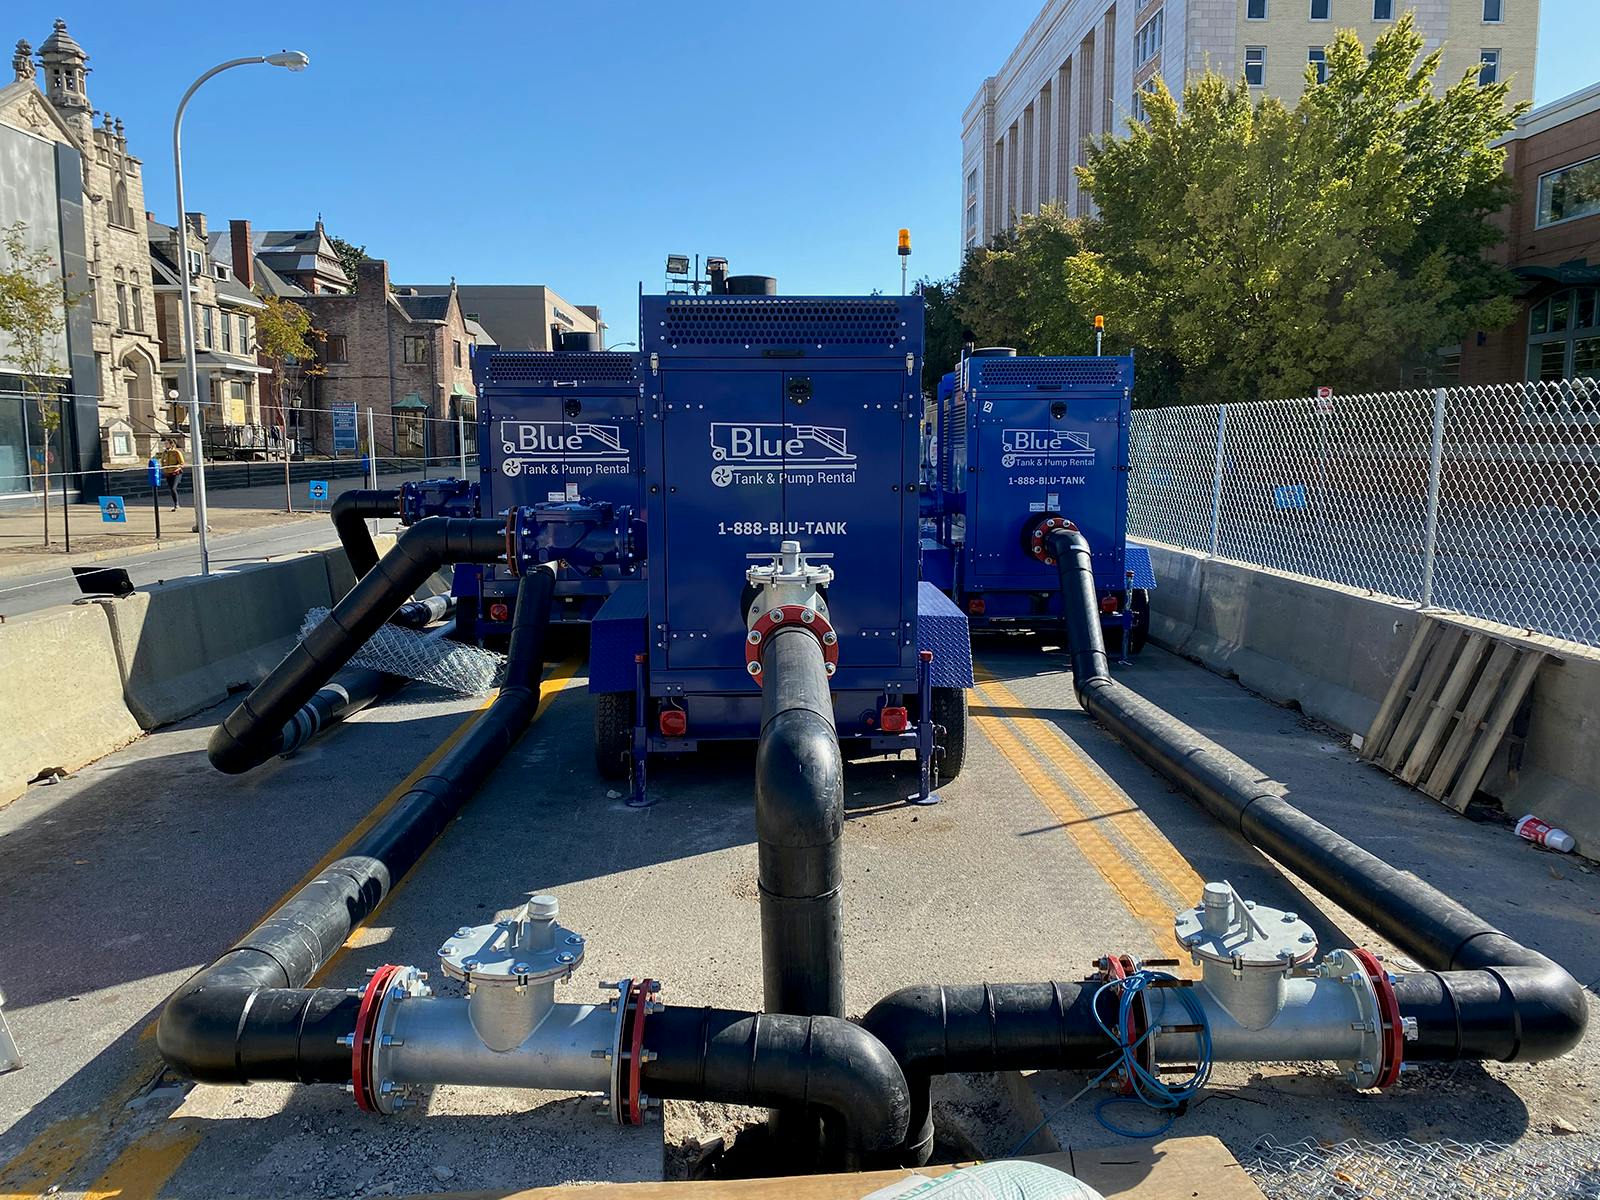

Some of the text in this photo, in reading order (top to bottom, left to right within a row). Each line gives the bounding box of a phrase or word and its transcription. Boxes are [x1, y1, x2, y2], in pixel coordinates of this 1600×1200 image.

[985, 403, 992, 412] 2
[518, 425, 583, 450] Blue
[731, 428, 804, 456] Blue
[1015, 432, 1062, 450] Blue
[522, 463, 630, 476] Tank & Pump Rental
[1016, 458, 1095, 467] Tank & Pump Rental
[733, 471, 856, 486] Tank & Pump Rental
[1008, 476, 1086, 485] 1-888-BLU-TANK
[718, 521, 847, 536] 1-888-BLU-TANK
